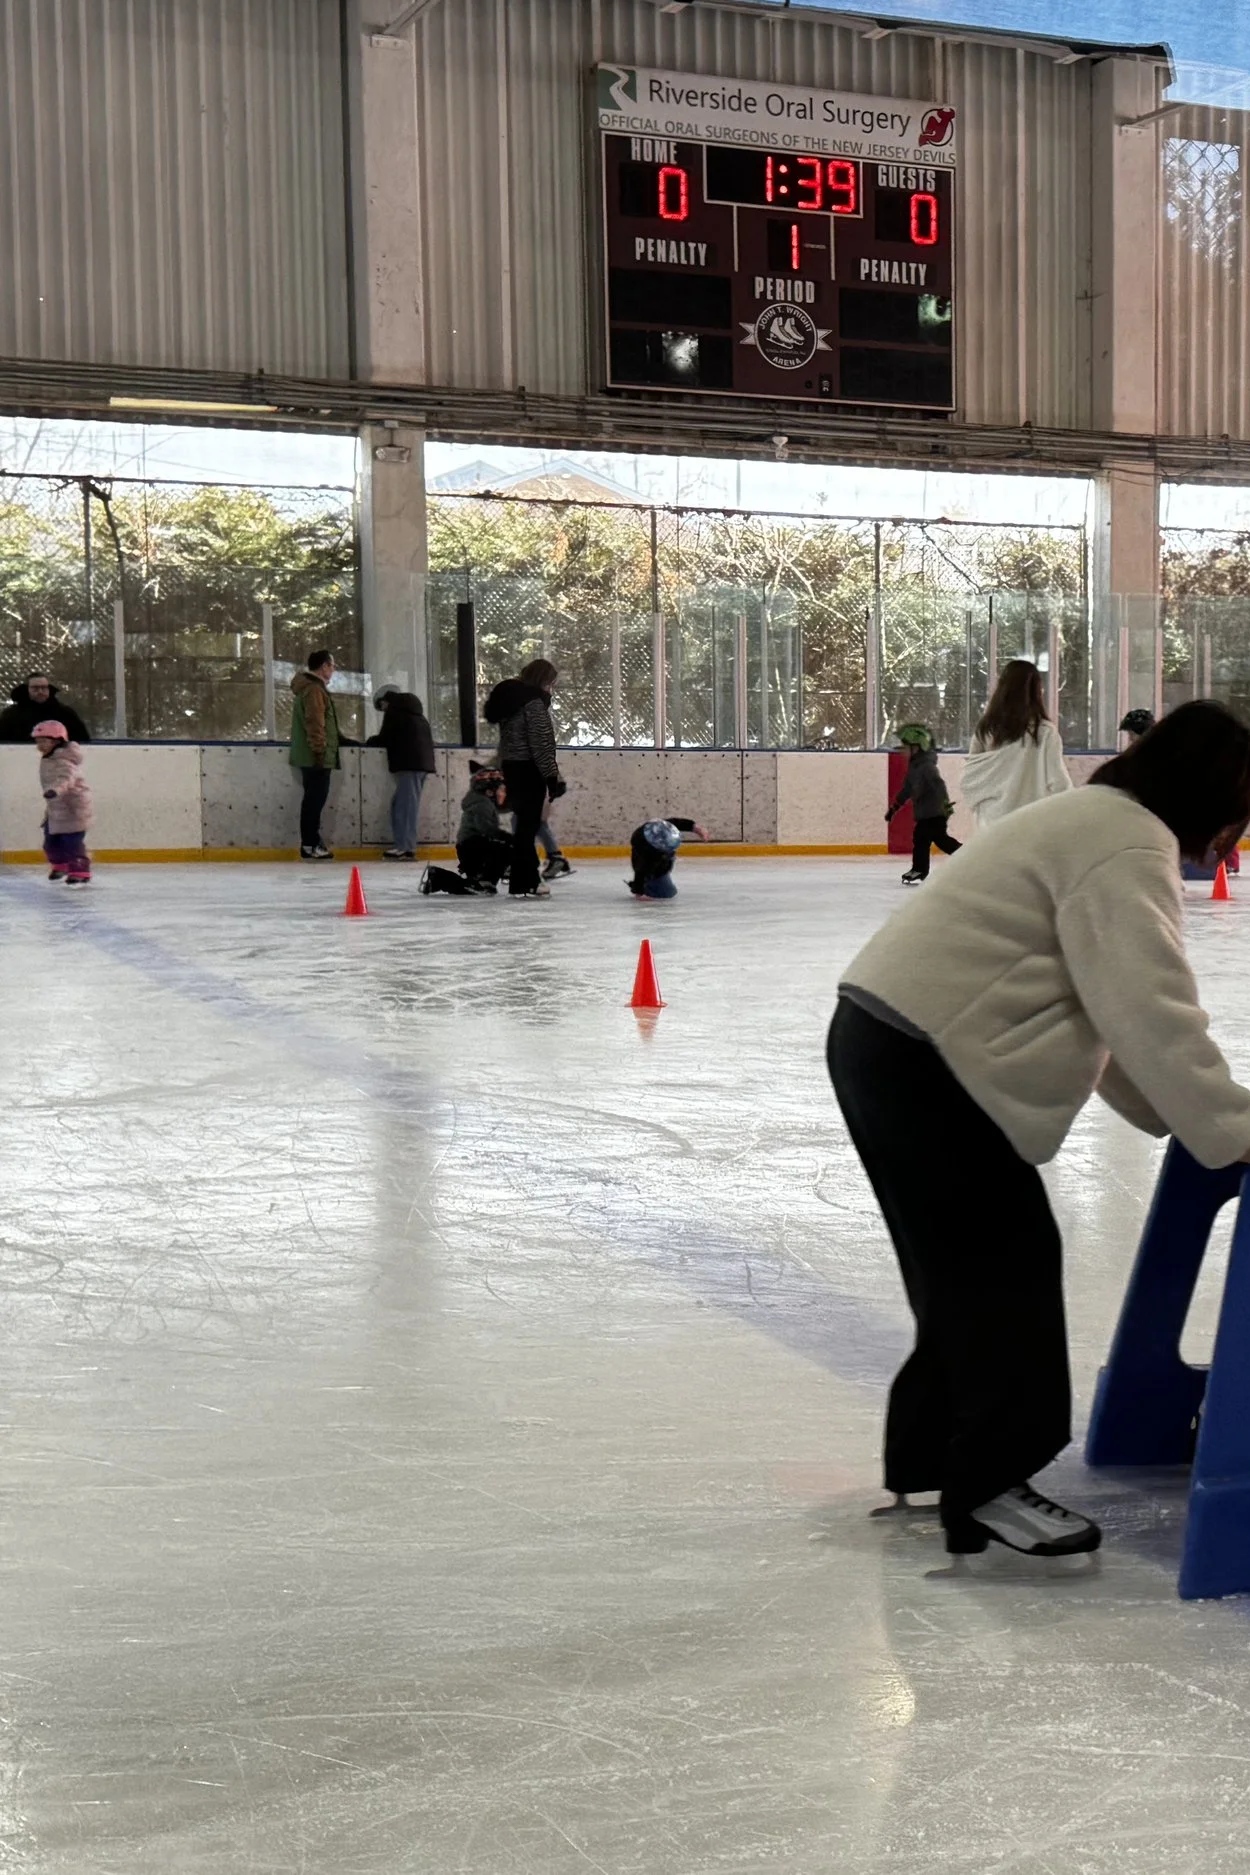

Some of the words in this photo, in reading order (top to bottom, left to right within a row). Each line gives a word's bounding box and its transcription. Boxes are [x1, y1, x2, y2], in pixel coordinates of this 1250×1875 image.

[649, 79, 758, 114] Riverside
[765, 93, 814, 121] Oral
[822, 100, 911, 137] Surgery
[599, 113, 660, 132] OFFICIAL
[664, 121, 702, 137] ORAL
[705, 125, 779, 144] SURGEONS
[782, 134, 801, 147] OF
[803, 136, 828, 151] THE
[832, 139, 863, 155] NEW
[867, 143, 910, 159] JERSEY
[914, 149, 956, 165] DEVILS
[630, 137, 678, 165] HOME
[765, 155, 857, 214] 1:39
[877, 164, 937, 192] GUESTS
[657, 166, 689, 222] 0
[909, 193, 938, 245] 0
[634, 236, 707, 267] PENALTY
[790, 223, 800, 270] 1
[859, 257, 928, 287] PENALTY
[754, 275, 816, 304] PERIOD
[759, 308, 777, 331] JOHN
[786, 305, 813, 333] WRIGHT
[772, 356, 802, 367] ARENA
